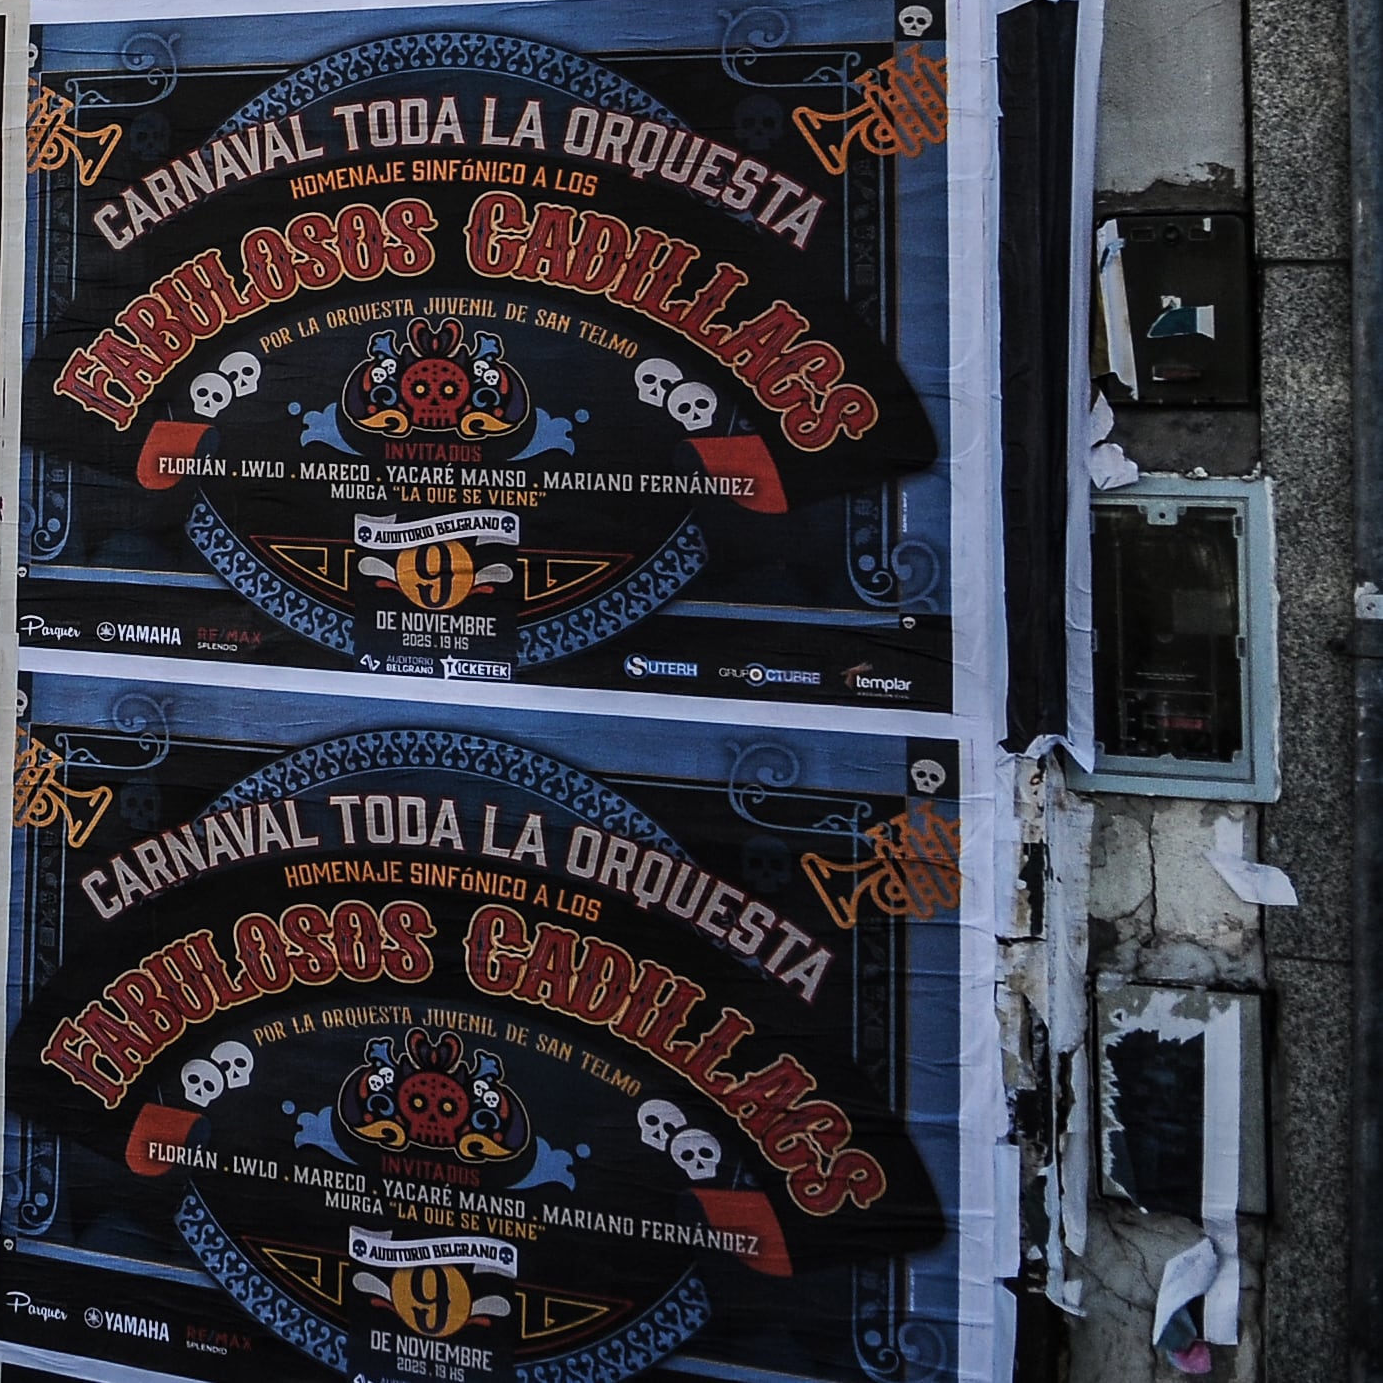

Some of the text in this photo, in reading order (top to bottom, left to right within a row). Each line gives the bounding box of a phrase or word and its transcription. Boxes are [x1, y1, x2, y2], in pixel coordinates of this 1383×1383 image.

[91, 95, 828, 253] CARNAVAL TODA LA ORQUESTA
[290, 161, 405, 200] HOMENAJE
[533, 166, 547, 187] A
[555, 171, 599, 198] LOS
[52, 191, 880, 454] FABULOSOS CADILLACS
[258, 297, 639, 360] POR LA ORQUESTA JUVENIL DE SAN TELMO
[159, 454, 755, 497] FLORIÁN LWLO MARECO YACARÉ MANSO MARIANO FERNÁNDEZ
[415, 542, 454, 608] 9
[117, 624, 181, 646] YAMAHA
[376, 611, 497, 637] DE NOVIEMBRE
[39, 899, 888, 1219] FABULOSOS CADILLACS
